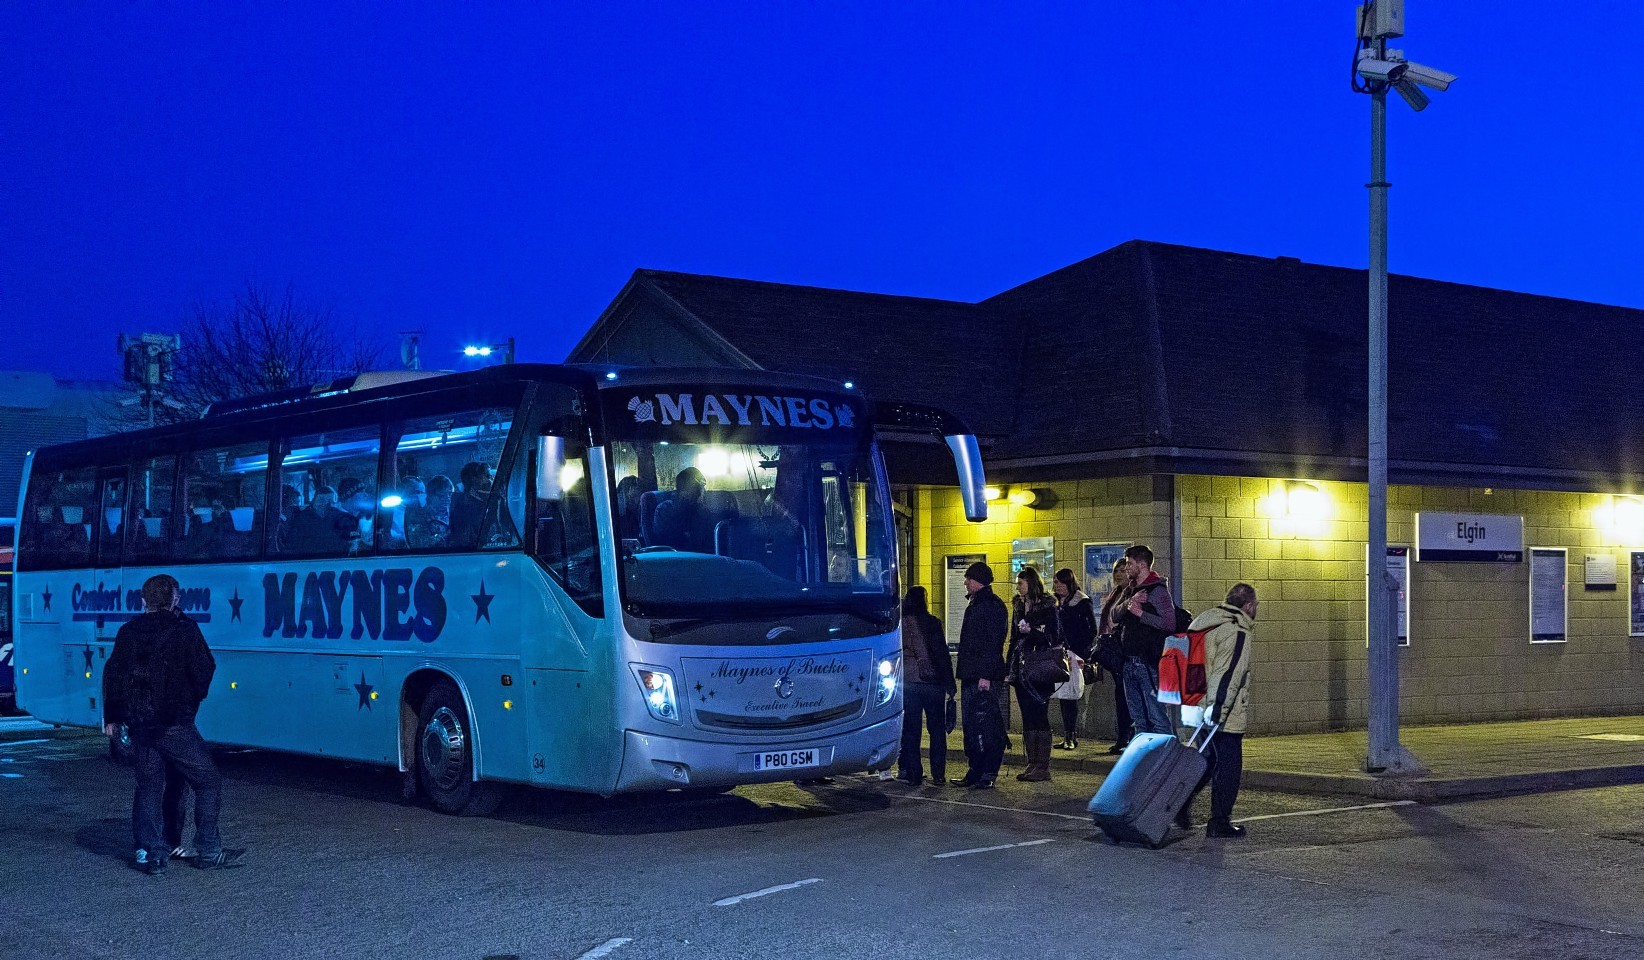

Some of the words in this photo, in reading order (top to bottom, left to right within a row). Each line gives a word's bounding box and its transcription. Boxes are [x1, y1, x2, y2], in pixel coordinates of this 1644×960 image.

[655, 393, 834, 430] MAYNES
[1457, 522, 1486, 543] Elgin
[72, 581, 122, 611] Comfort
[262, 566, 447, 643] MAYNES
[710, 660, 776, 685] Maynes
[778, 658, 796, 678] of
[797, 658, 849, 675] Buckie
[744, 699, 788, 712] Executive
[791, 696, 825, 709] Travel
[534, 757, 544, 769] 34
[765, 754, 788, 767] P80
[791, 751, 813, 765] GSM
